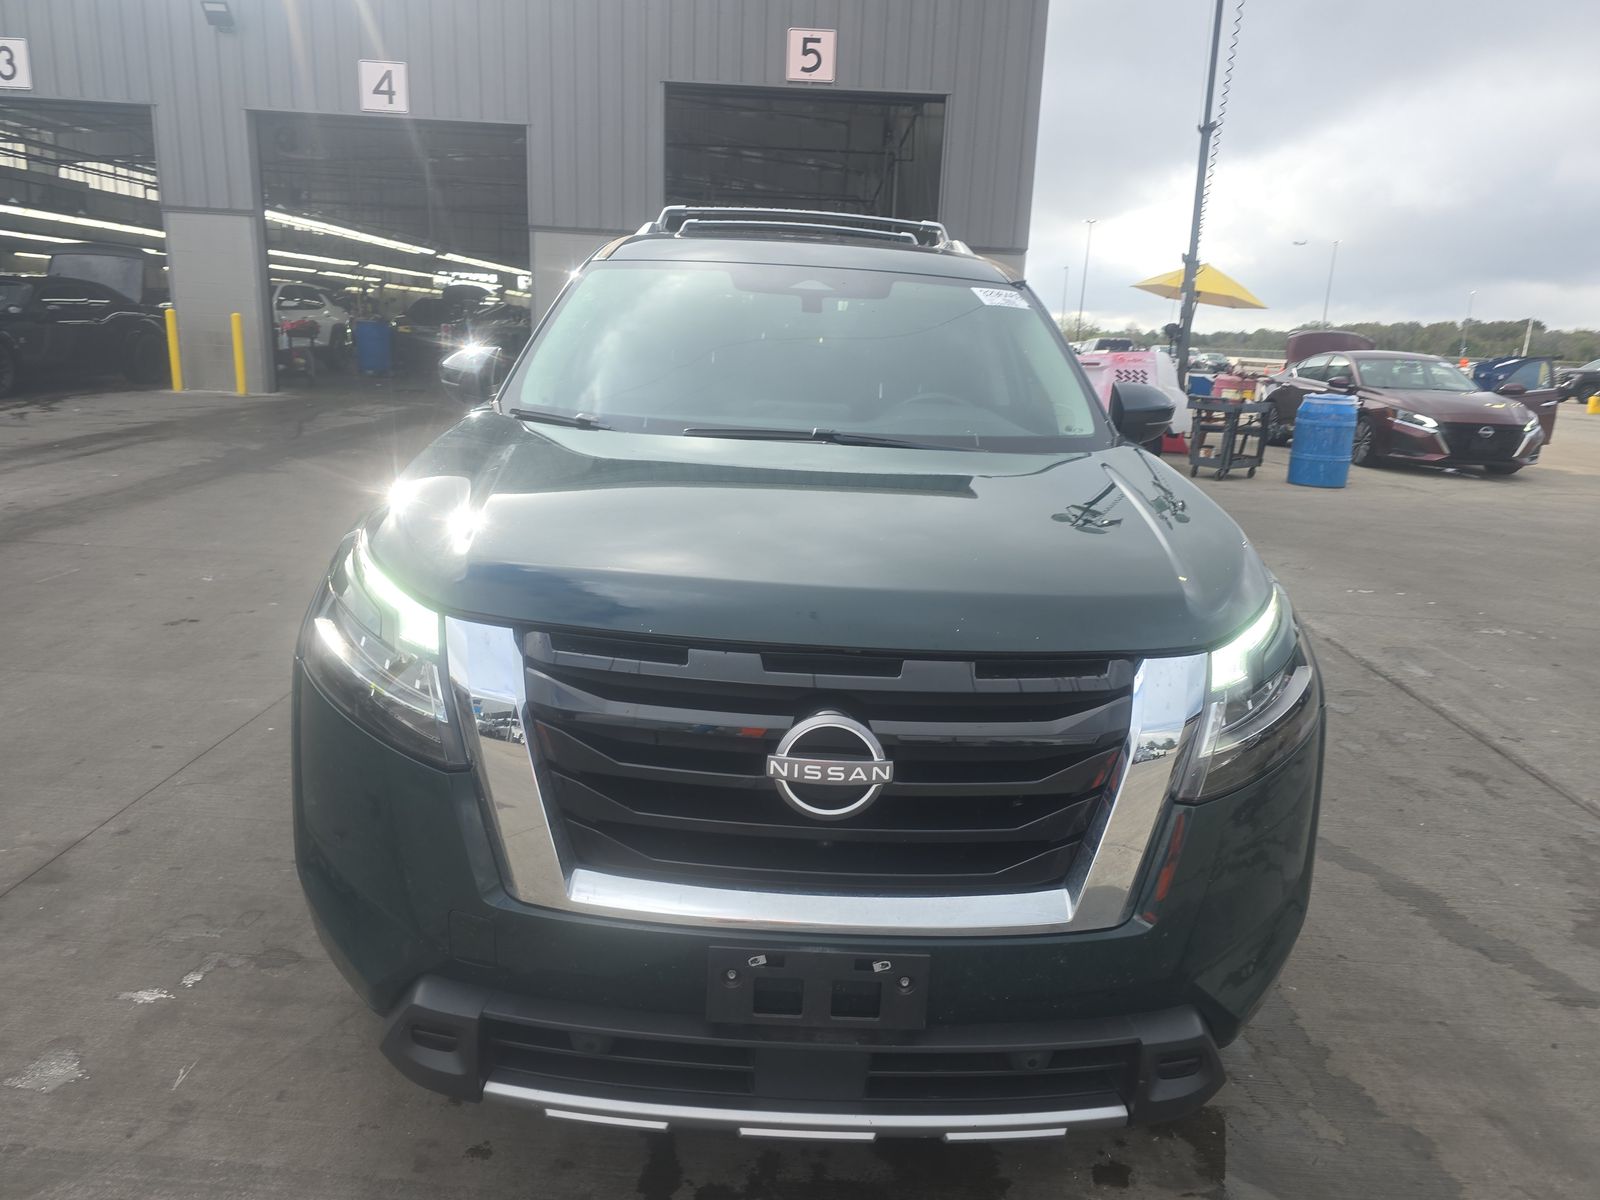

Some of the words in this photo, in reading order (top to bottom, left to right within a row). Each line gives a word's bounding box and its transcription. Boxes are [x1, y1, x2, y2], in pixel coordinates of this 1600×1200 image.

[0, 46, 16, 80] 3
[800, 37, 822, 73] 5
[372, 69, 396, 104] 4
[769, 760, 890, 782] NISSAN
